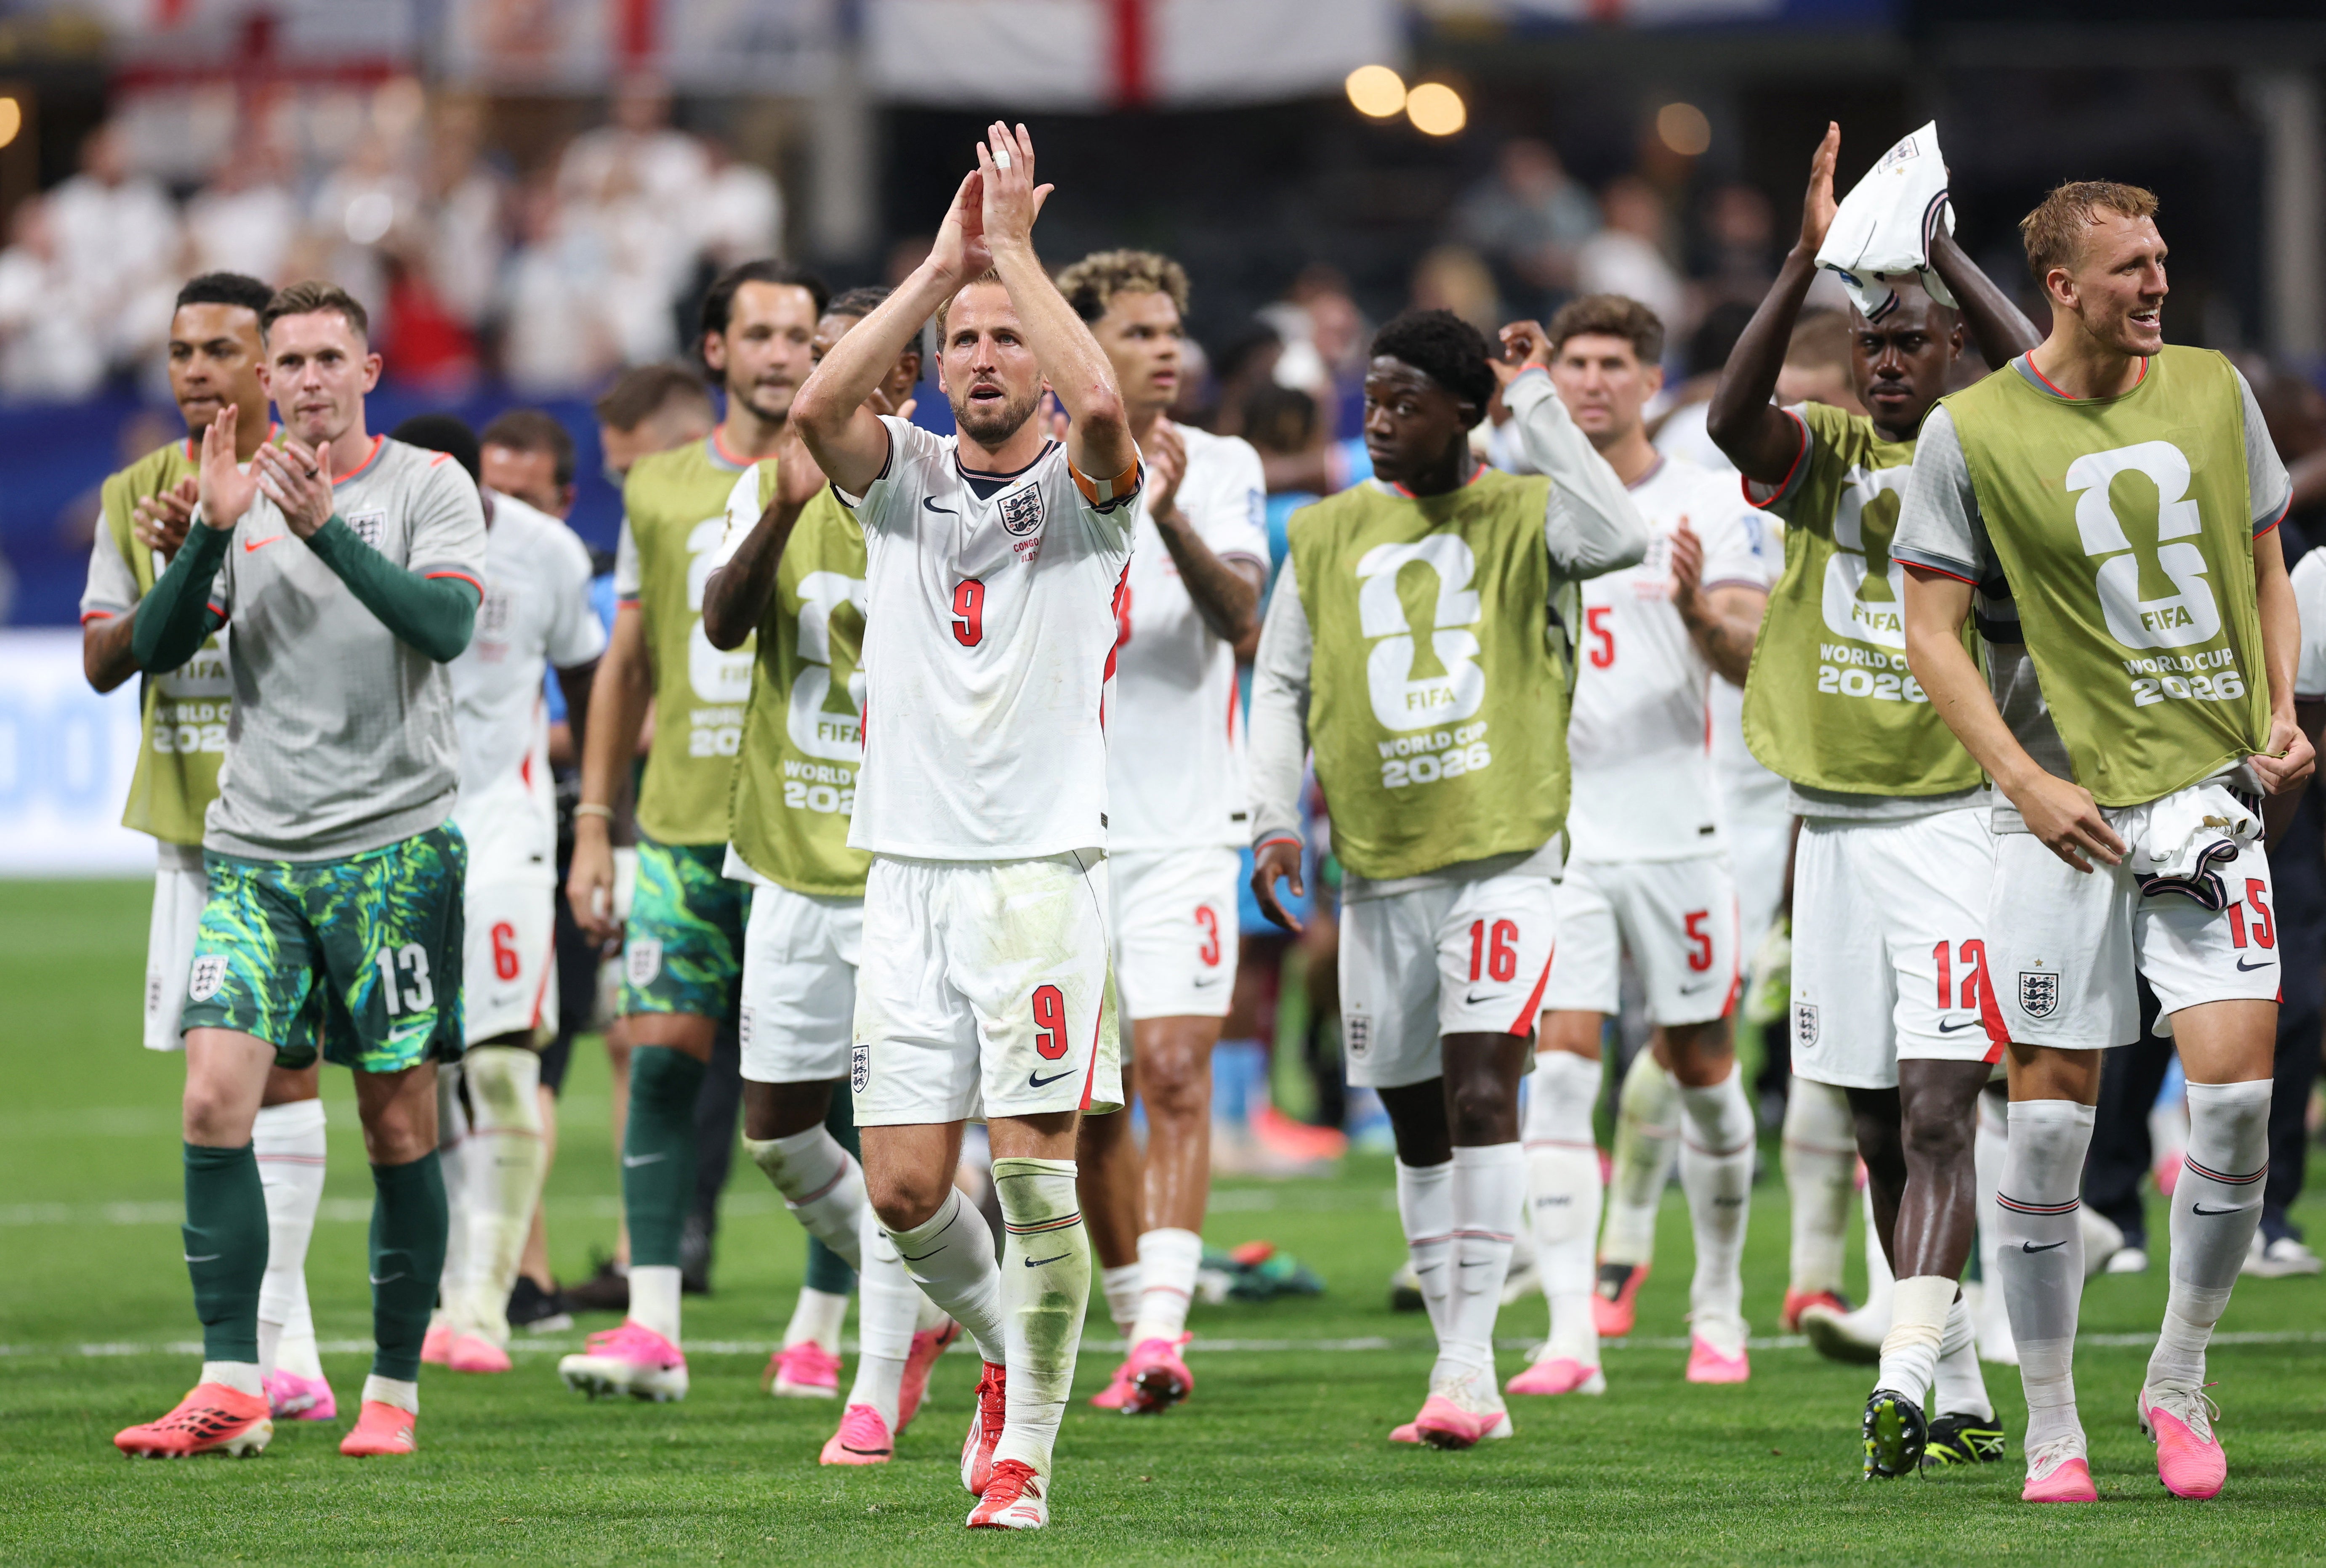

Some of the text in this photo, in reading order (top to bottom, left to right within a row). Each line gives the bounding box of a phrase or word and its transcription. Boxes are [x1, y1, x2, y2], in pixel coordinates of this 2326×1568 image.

[1013, 537, 1039, 553] CONGO
[952, 579, 985, 647] 9
[1852, 603, 1902, 632] FIFA
[2140, 605, 2194, 632] FIFA
[1587, 606, 1615, 669] 5
[1820, 642, 1887, 669] WORLD
[2122, 647, 2233, 675] WORLD CUP
[1406, 687, 1456, 711] FIFA
[1818, 664, 1929, 703] 2026
[2130, 670, 2245, 707] 2026
[153, 724, 226, 753] 202
[689, 728, 742, 757] 20
[1377, 721, 1488, 758] WORLD CUP
[784, 759, 851, 785] WORLD
[1381, 741, 1492, 789] 2026
[784, 781, 855, 815] 202
[2227, 877, 2275, 950] 15
[492, 922, 519, 981] 6
[1195, 904, 1220, 967] 3
[1469, 919, 1519, 982] 16
[1685, 910, 1712, 972] 5
[375, 942, 434, 1015] 13
[1933, 938, 1984, 1009] 12
[1032, 985, 1068, 1060] 9
